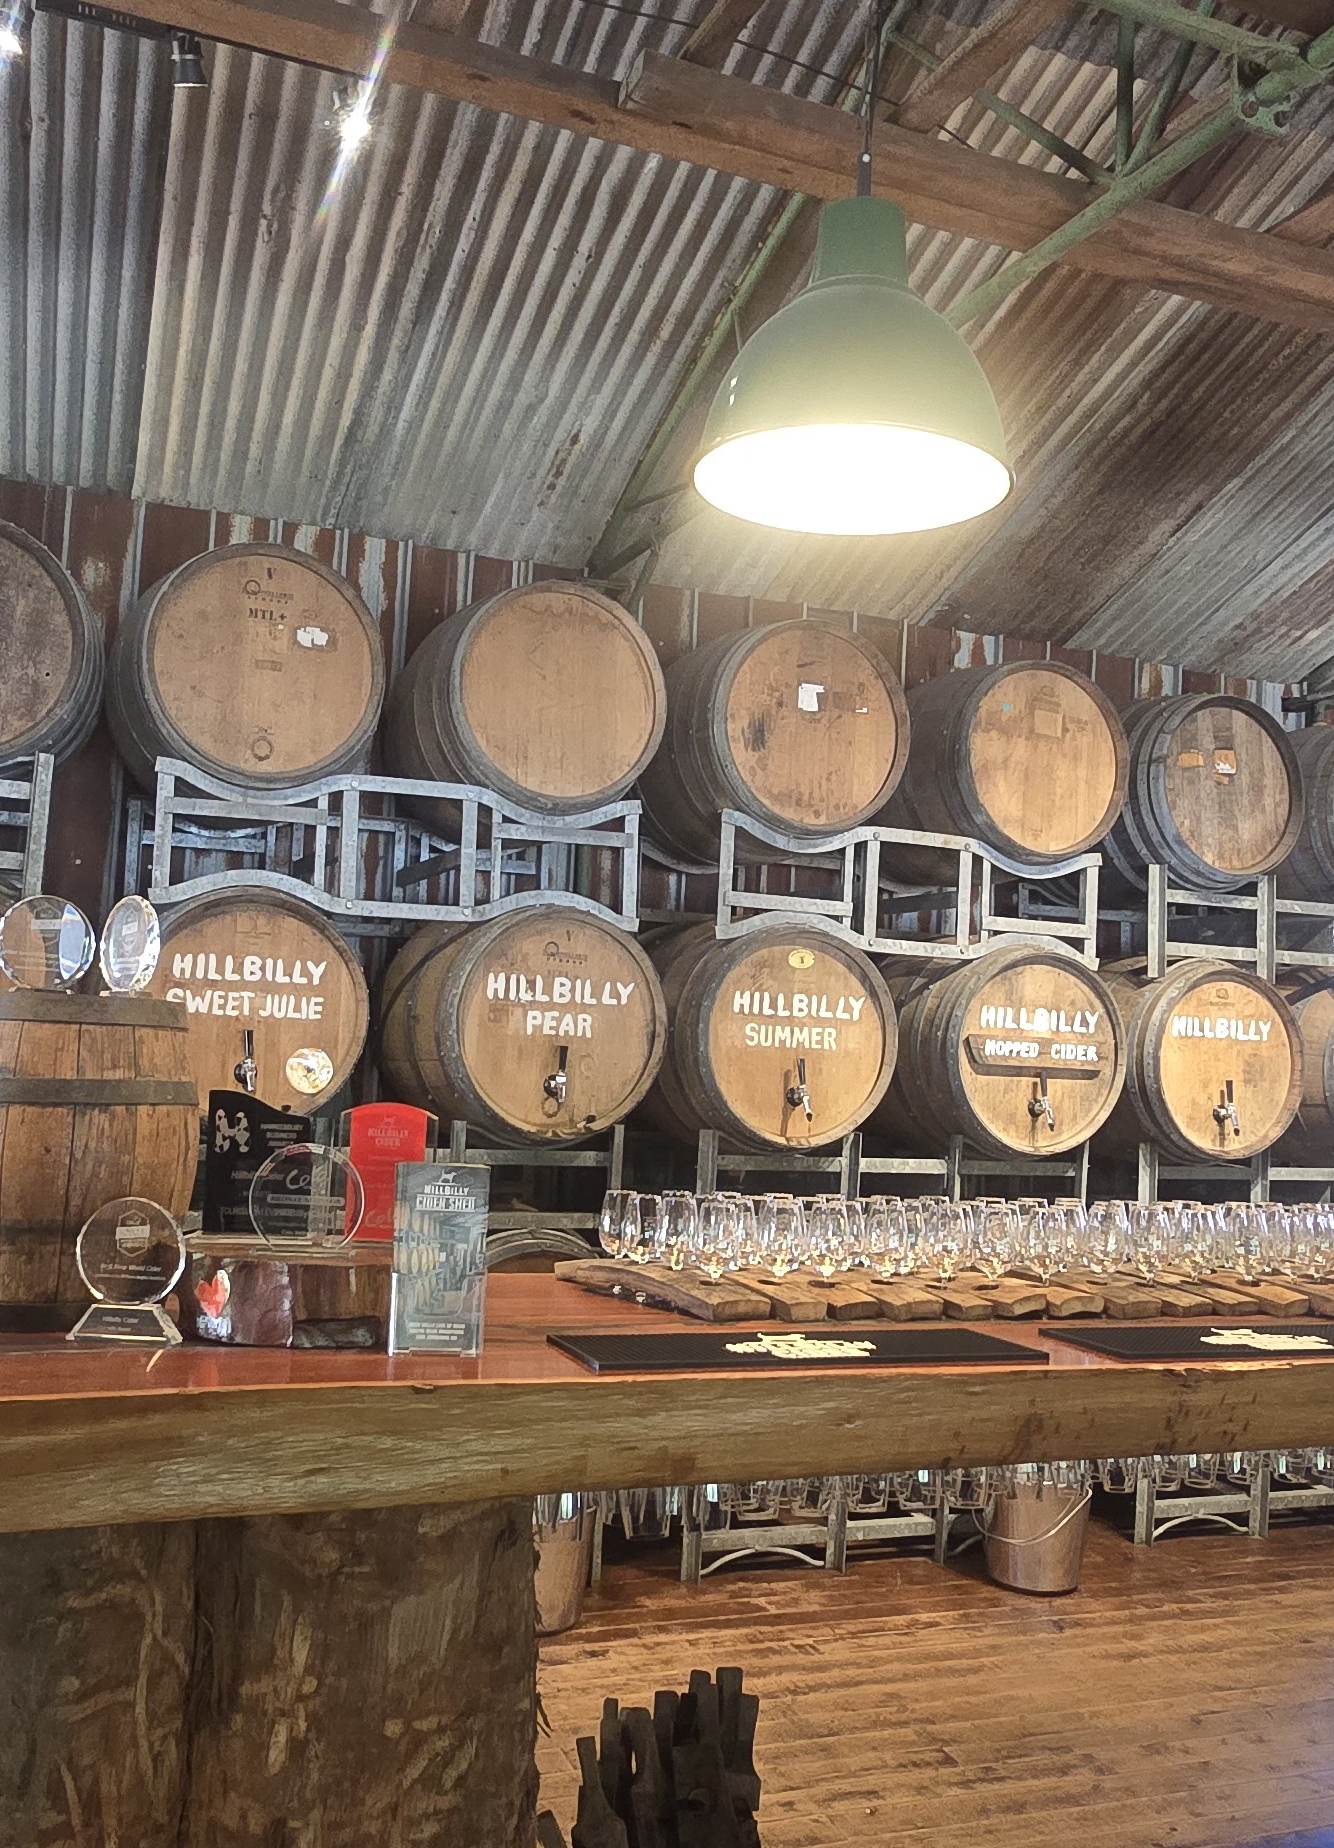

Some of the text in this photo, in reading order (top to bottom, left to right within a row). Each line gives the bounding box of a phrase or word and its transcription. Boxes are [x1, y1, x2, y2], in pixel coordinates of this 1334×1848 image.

[172, 953, 327, 985] HILLBILLY
[486, 972, 635, 1005] HILLBILLY
[258, 993, 325, 1020] JULIE
[733, 990, 865, 1021] HILLBILLY
[980, 1004, 1099, 1034] HILLBILLY
[526, 1010, 592, 1038] PEAR
[745, 1022, 837, 1051] SUMMER
[1171, 1015, 1272, 1041] HILLBILLY
[984, 1039, 1099, 1061] HOPPED CIDER
[416, 1196, 475, 1210] CIDER SHED
[424, 1184, 469, 1195] HILLBILLY
